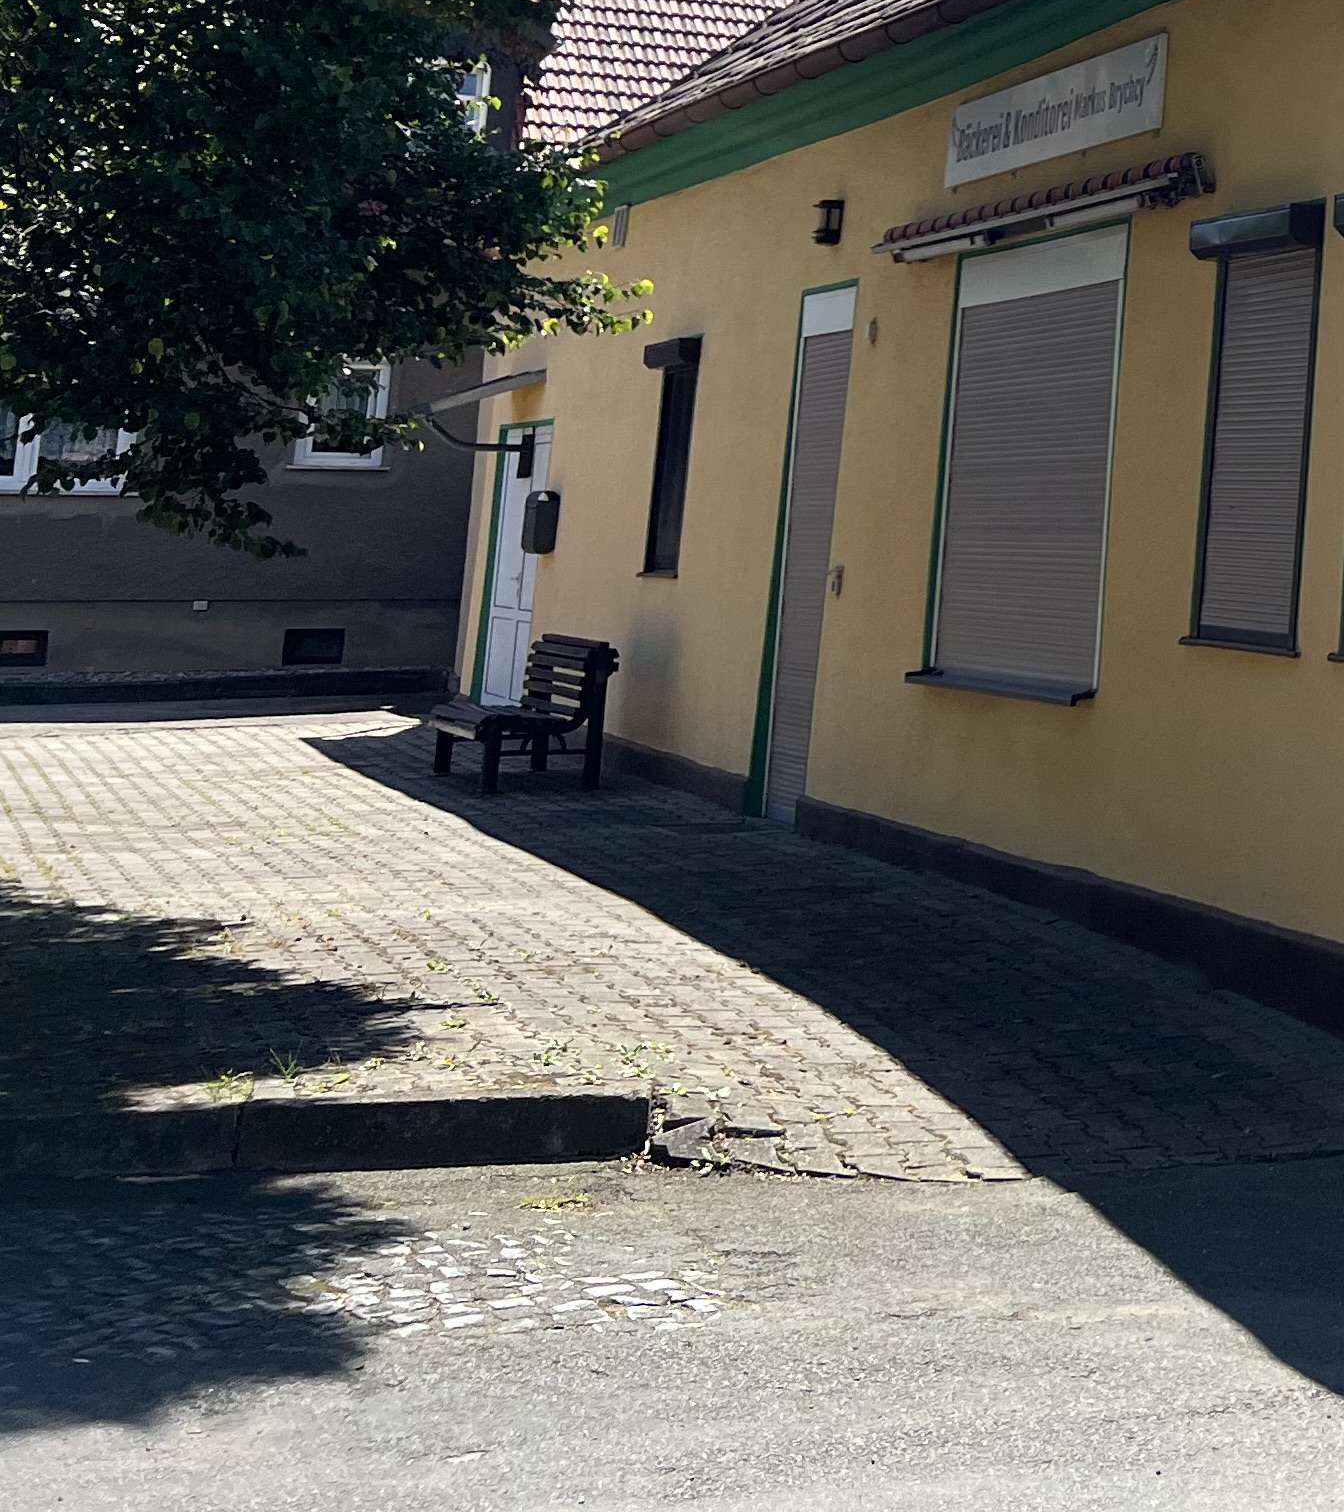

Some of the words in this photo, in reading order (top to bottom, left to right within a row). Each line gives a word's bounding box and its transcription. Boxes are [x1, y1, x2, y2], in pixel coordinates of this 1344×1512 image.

[956, 112, 1003, 163] Bäckerei
[1003, 111, 1012, 149] &
[1013, 88, 1073, 145] Konditorei
